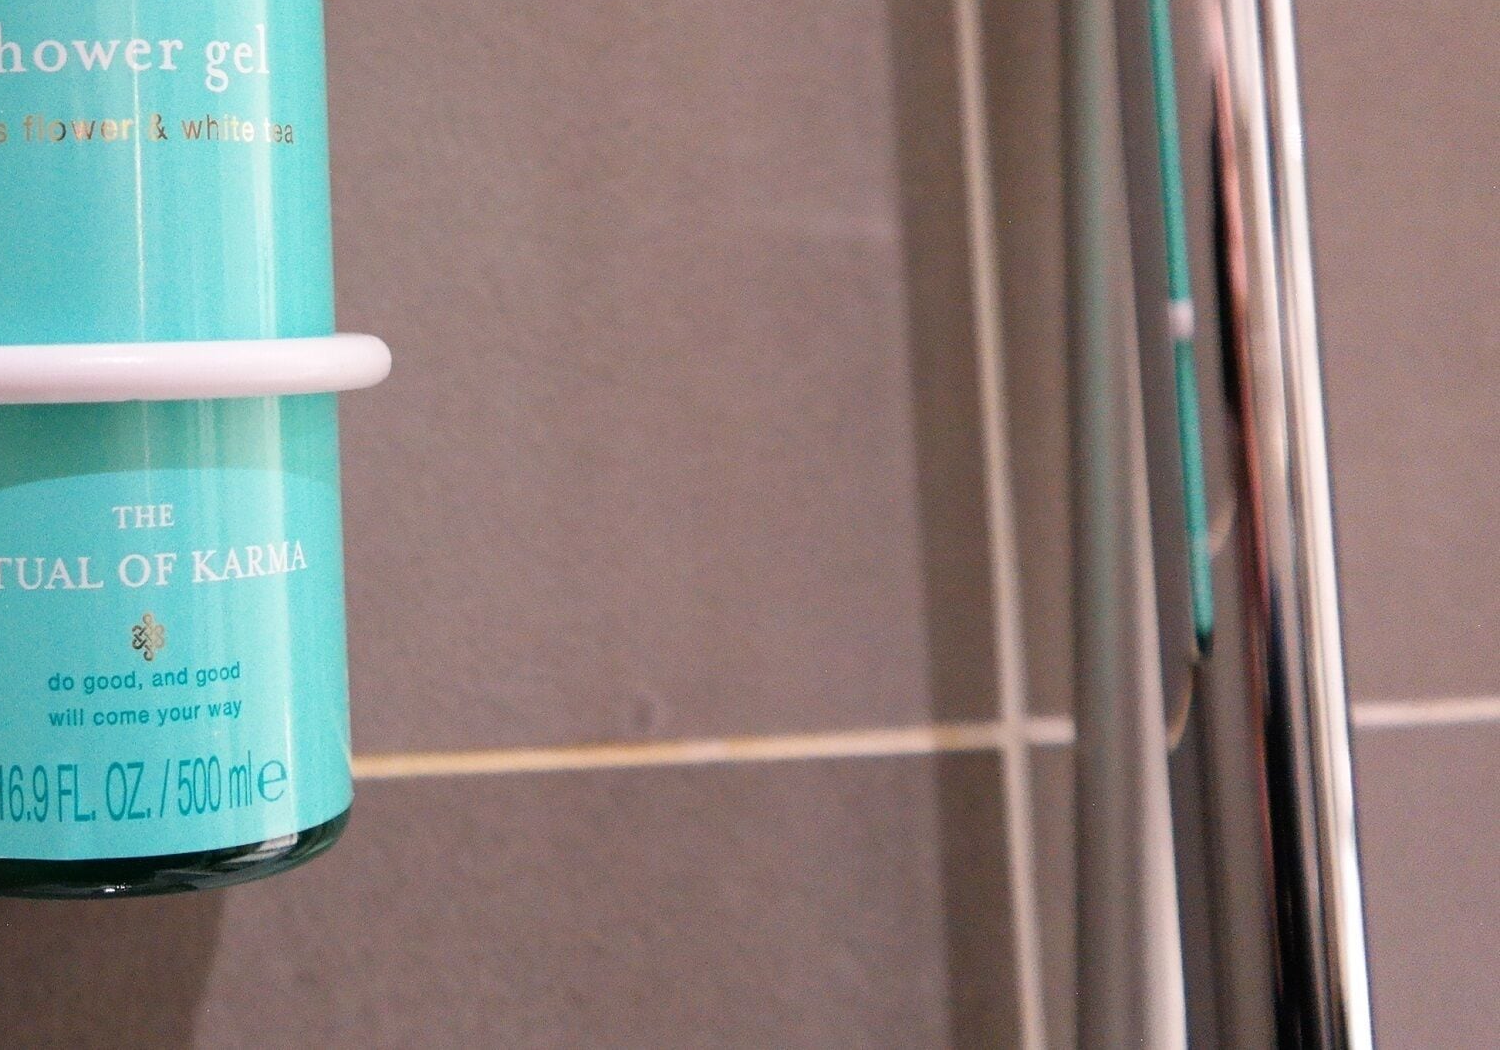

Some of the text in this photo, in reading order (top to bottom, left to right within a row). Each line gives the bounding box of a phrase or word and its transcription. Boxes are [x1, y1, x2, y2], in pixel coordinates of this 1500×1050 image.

[205, 24, 270, 92] gel
[23, 114, 134, 143] flower
[149, 113, 168, 140] &
[182, 114, 254, 142] white
[264, 118, 294, 144] tea
[112, 504, 174, 529] THE
[118, 553, 177, 587] OF
[192, 541, 308, 583] KARMA
[48, 662, 241, 694] do good, and good
[49, 700, 242, 727] will come your way
[58, 762, 97, 822] FL.
[106, 762, 151, 819] OZ.
[159, 758, 170, 817] /
[178, 755, 222, 816] 500
[229, 750, 253, 808] ml
